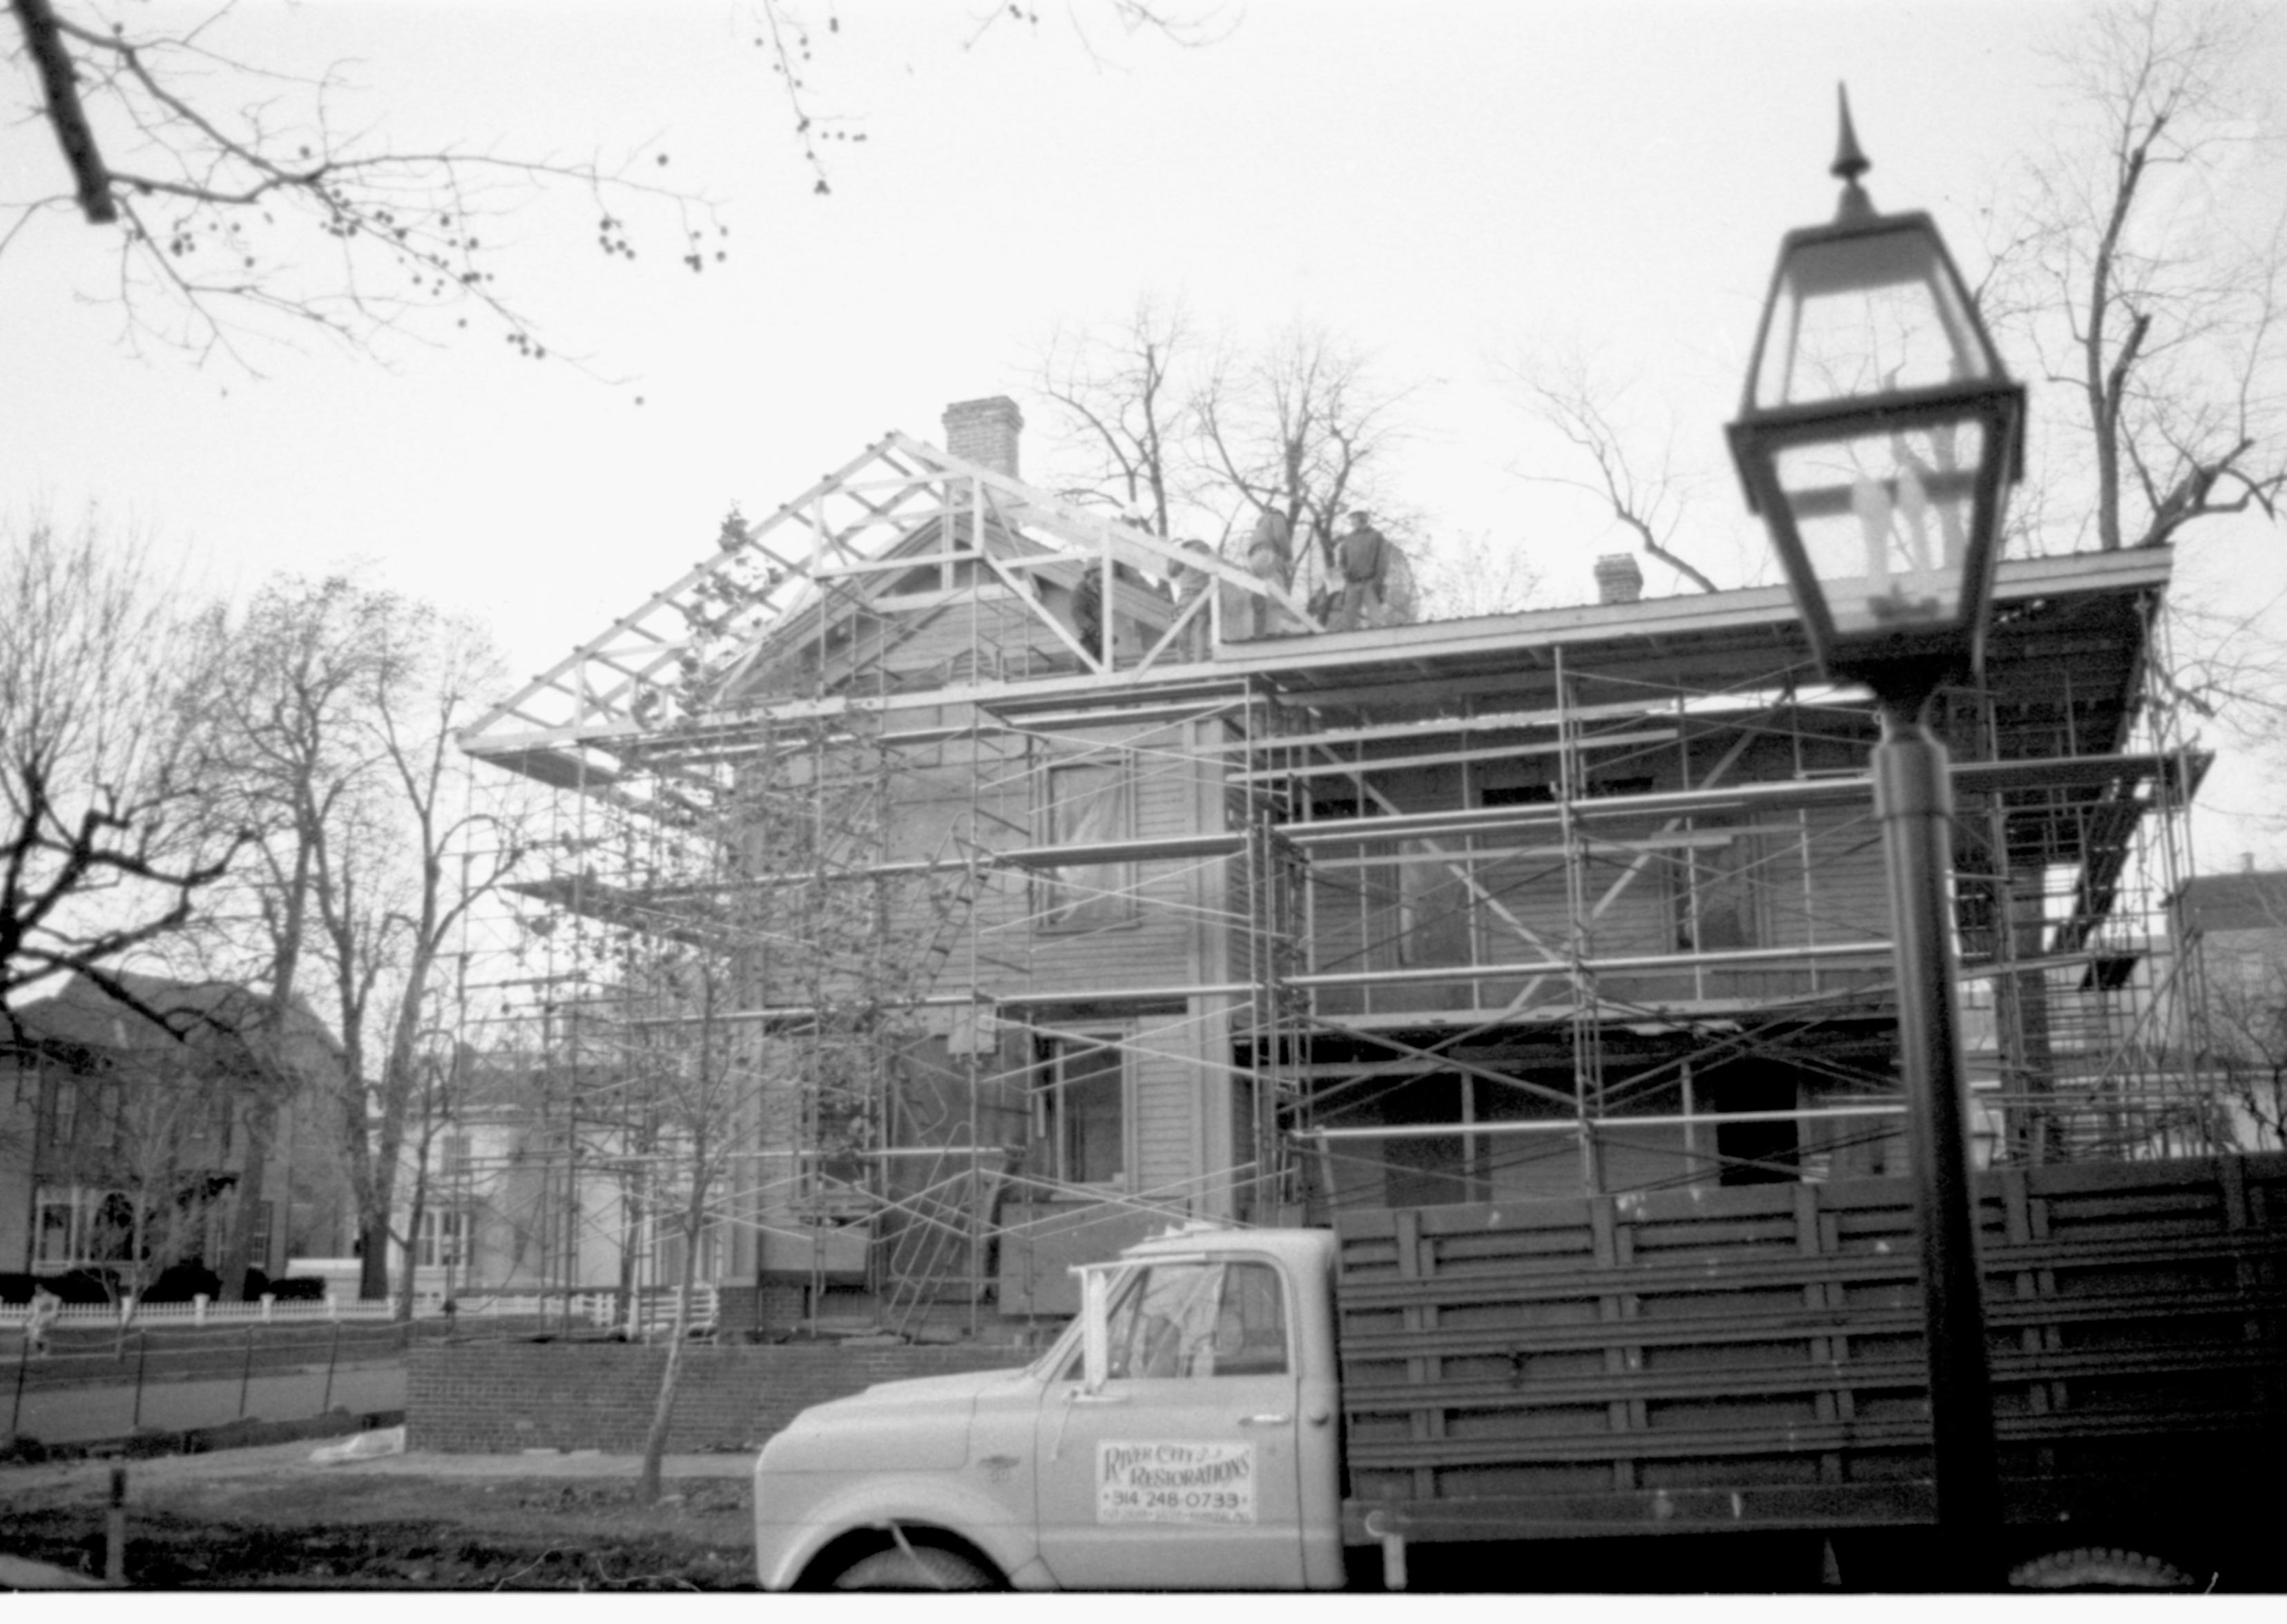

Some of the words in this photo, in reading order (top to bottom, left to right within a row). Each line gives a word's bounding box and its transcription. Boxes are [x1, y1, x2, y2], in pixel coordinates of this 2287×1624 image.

[1104, 1446, 1152, 1484] RIVER
[1130, 1449, 1251, 1488] RESTORATIONS
[1113, 1490, 1139, 1505] 314
